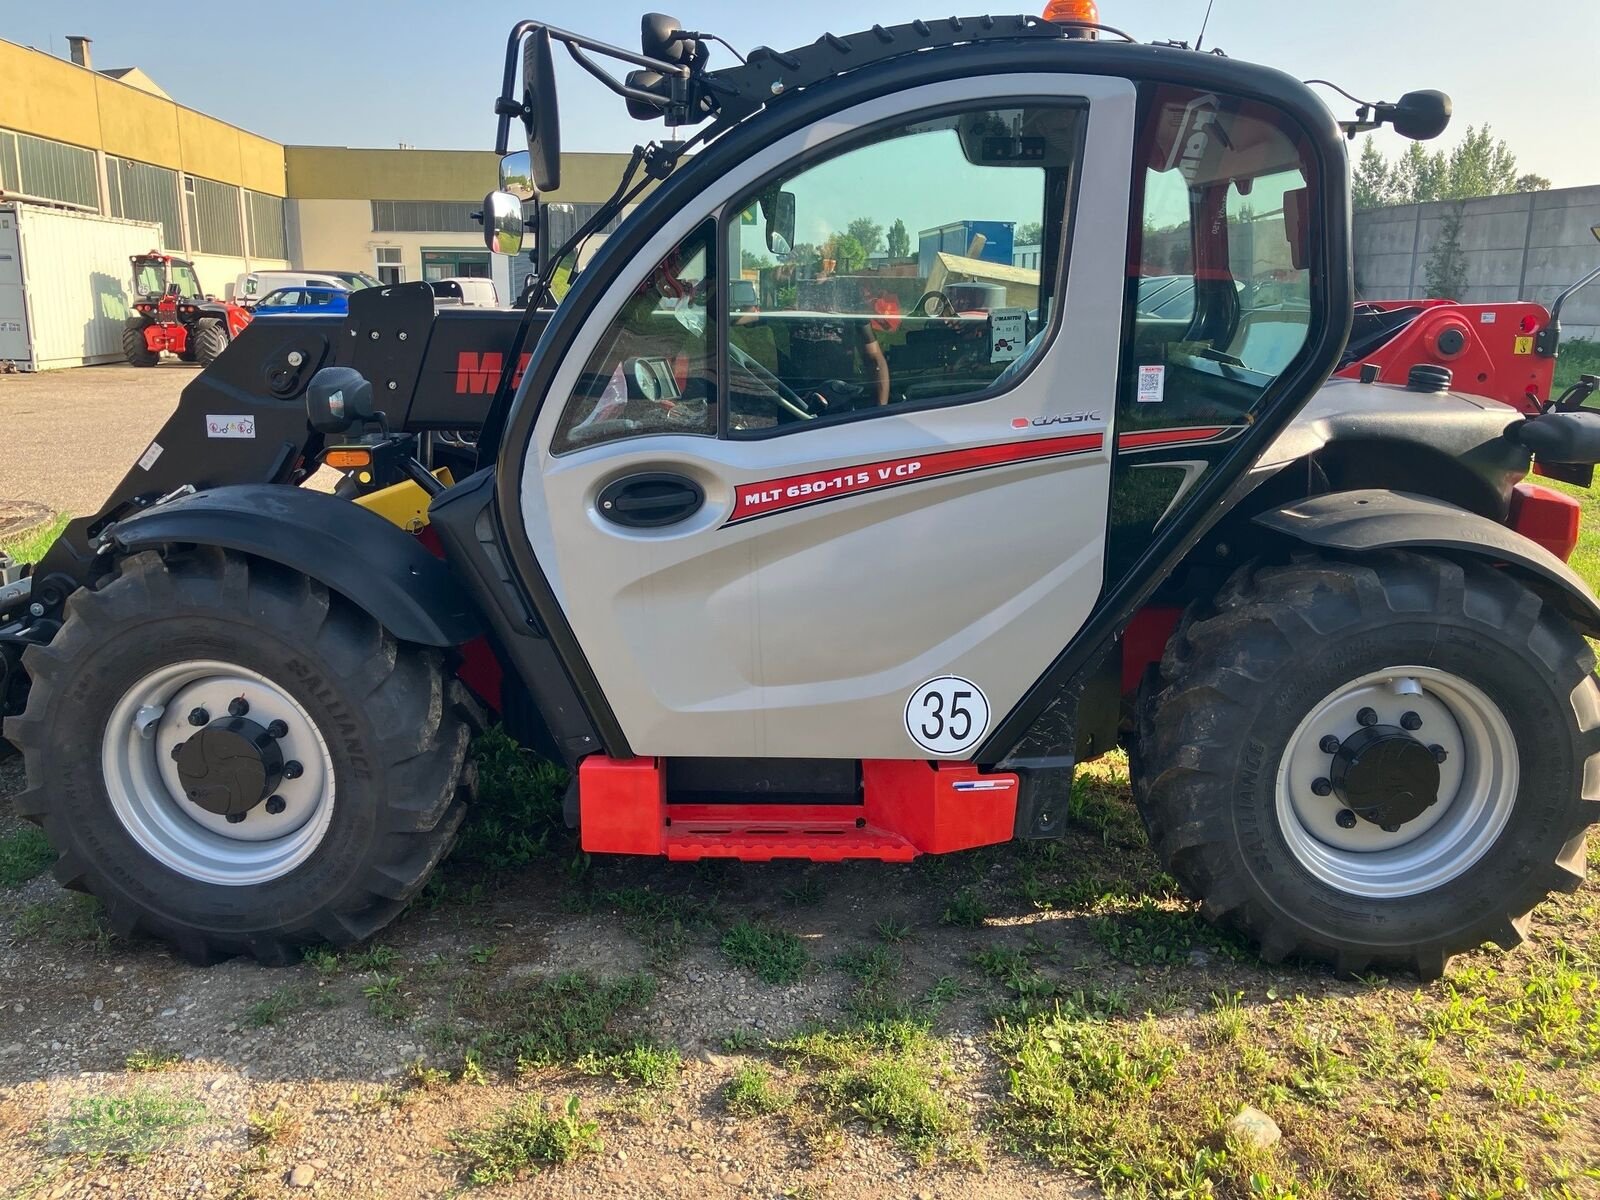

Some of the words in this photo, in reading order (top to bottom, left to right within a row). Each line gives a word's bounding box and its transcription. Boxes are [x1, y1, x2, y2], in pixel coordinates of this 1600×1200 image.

[1032, 410, 1100, 426] CLASSIC
[745, 488, 783, 506] MLT
[787, 472, 870, 498] 630-115
[878, 467, 892, 480] V
[895, 461, 922, 475] CP
[301, 674, 373, 779] ALLIANCE
[921, 691, 972, 740] 35
[1239, 740, 1268, 856] ALLIANCE
